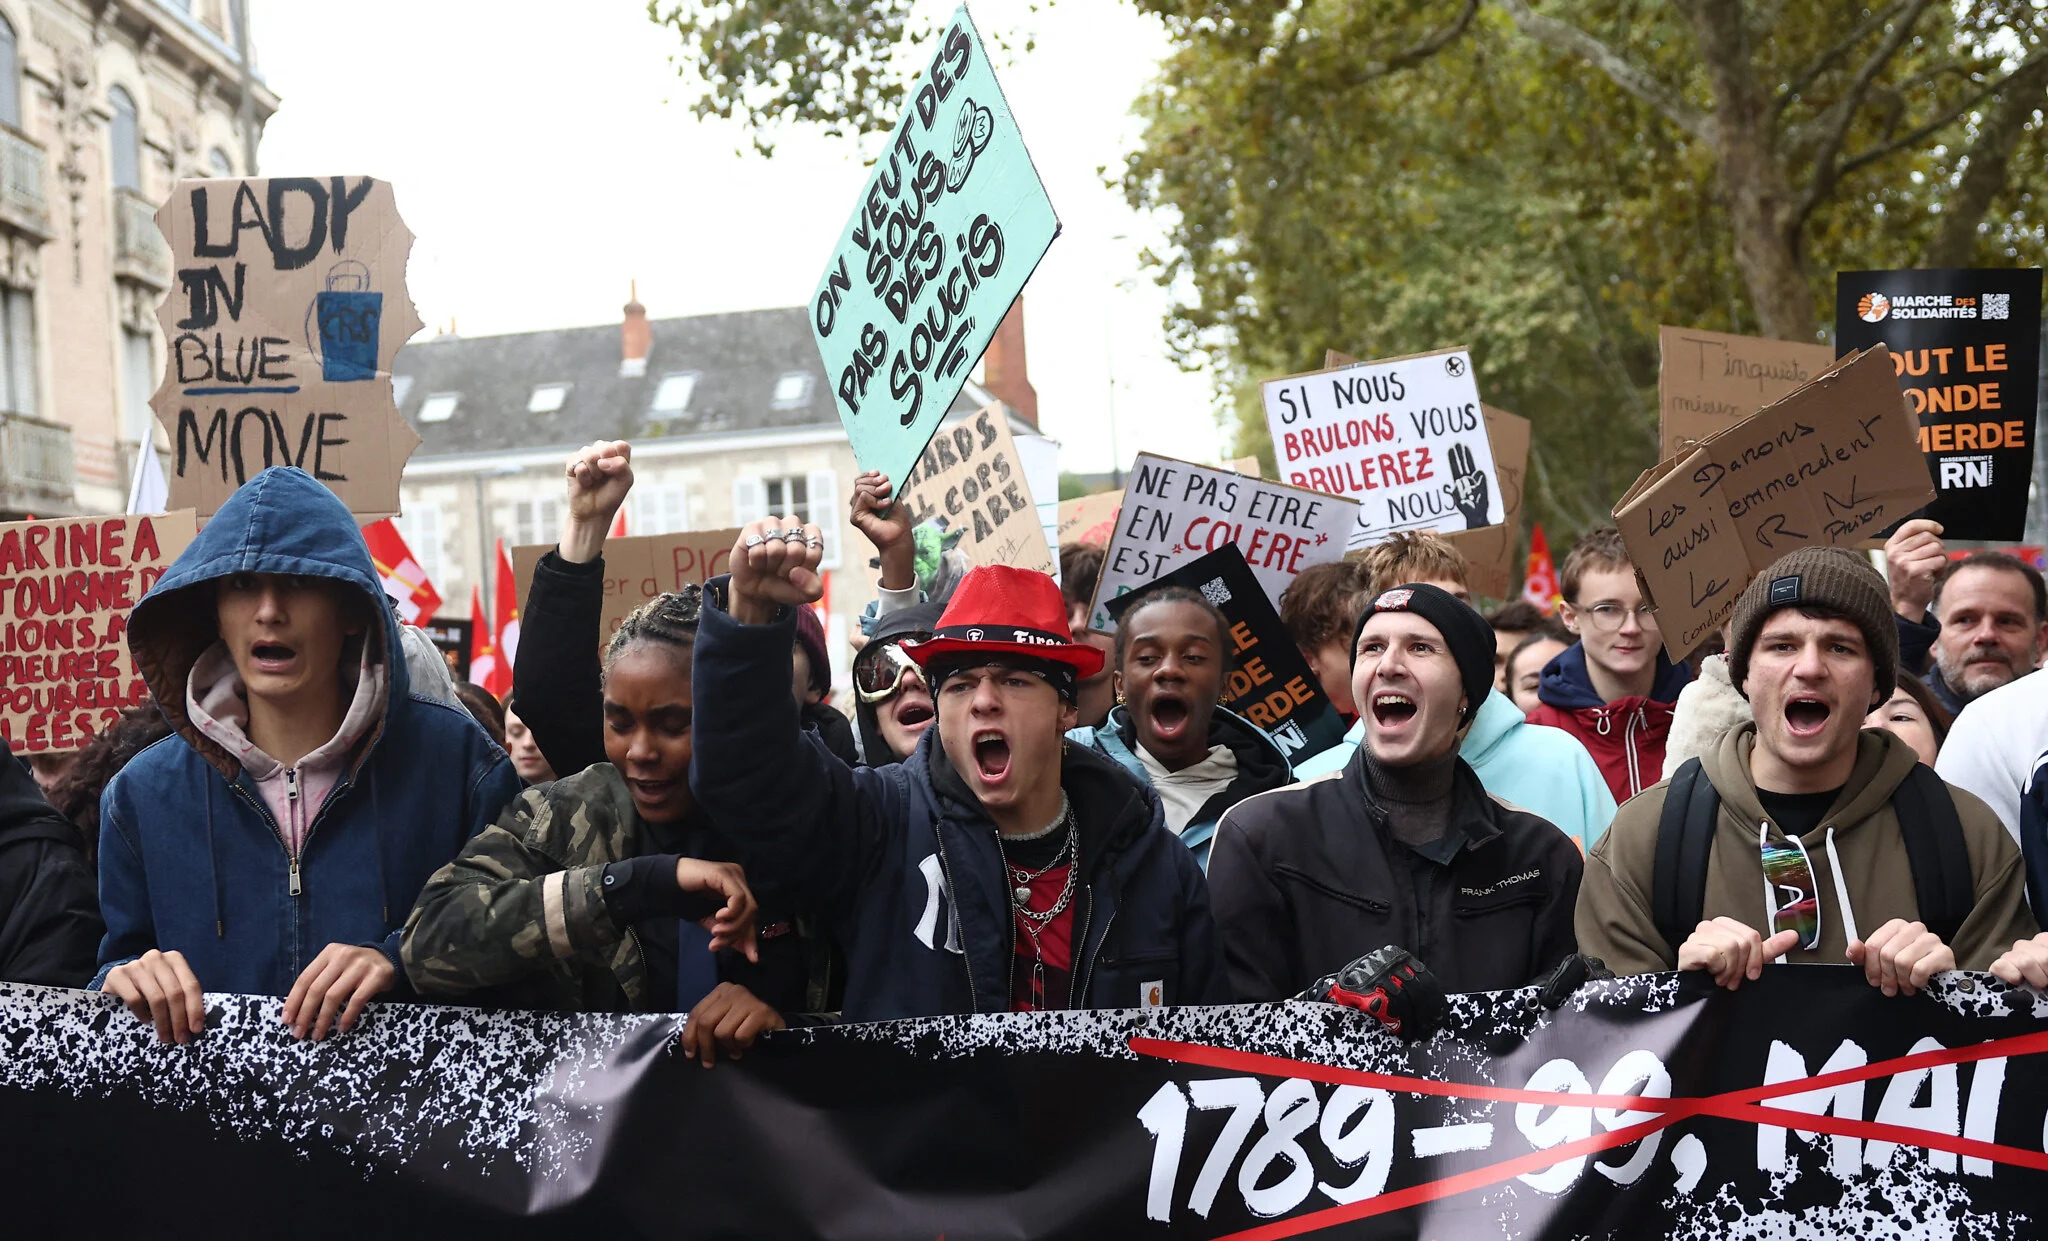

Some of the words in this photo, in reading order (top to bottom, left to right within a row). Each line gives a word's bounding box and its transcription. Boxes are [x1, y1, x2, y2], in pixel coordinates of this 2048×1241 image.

[816, 254, 852, 338] ON
[852, 109, 918, 253] VEUT
[915, 22, 973, 133] DES
[191, 176, 374, 271] LADY
[866, 149, 947, 299] SOUS
[177, 261, 247, 331] IN
[839, 321, 889, 417] PAS
[884, 219, 946, 325] DES
[1891, 295, 1953, 307] MARCHE
[1955, 297, 1977, 307] DES
[1891, 305, 1978, 320] SOLIDARITÉS
[321, 306, 378, 344] CRS
[174, 331, 297, 384] BLUE
[1965, 343, 2009, 373] LE
[1279, 386, 1312, 424] SI
[1332, 372, 1406, 409] NOUS
[177, 406, 350, 487] MOVE
[1284, 412, 1402, 461] BRULONS,
[1410, 403, 1477, 439] VOUS
[945, 452, 1011, 516] COPS
[1290, 447, 1434, 494] BRULEREZ
[1940, 461, 1988, 489] RN
[972, 480, 1028, 544] ARE
[1134, 464, 1177, 499] NE
[1182, 473, 1240, 513] PAS
[1247, 490, 1323, 530] ETRE
[1387, 484, 1458, 523] NOUS
[1648, 503, 1687, 537] Les
[131, 516, 161, 562] A
[1126, 504, 1173, 543] EN
[1663, 507, 1718, 570] aussi
[1112, 546, 1170, 579] EST
[1690, 571, 1730, 608] Le
[1755, 513, 1809, 549] R
[0, 616, 107, 653] IONS,
[0, 649, 121, 685] PLEUREZ
[1461, 886, 1496, 897] FRANK
[1496, 868, 1541, 889] THOMAS
[1757, 1036, 2008, 1179] MAI
